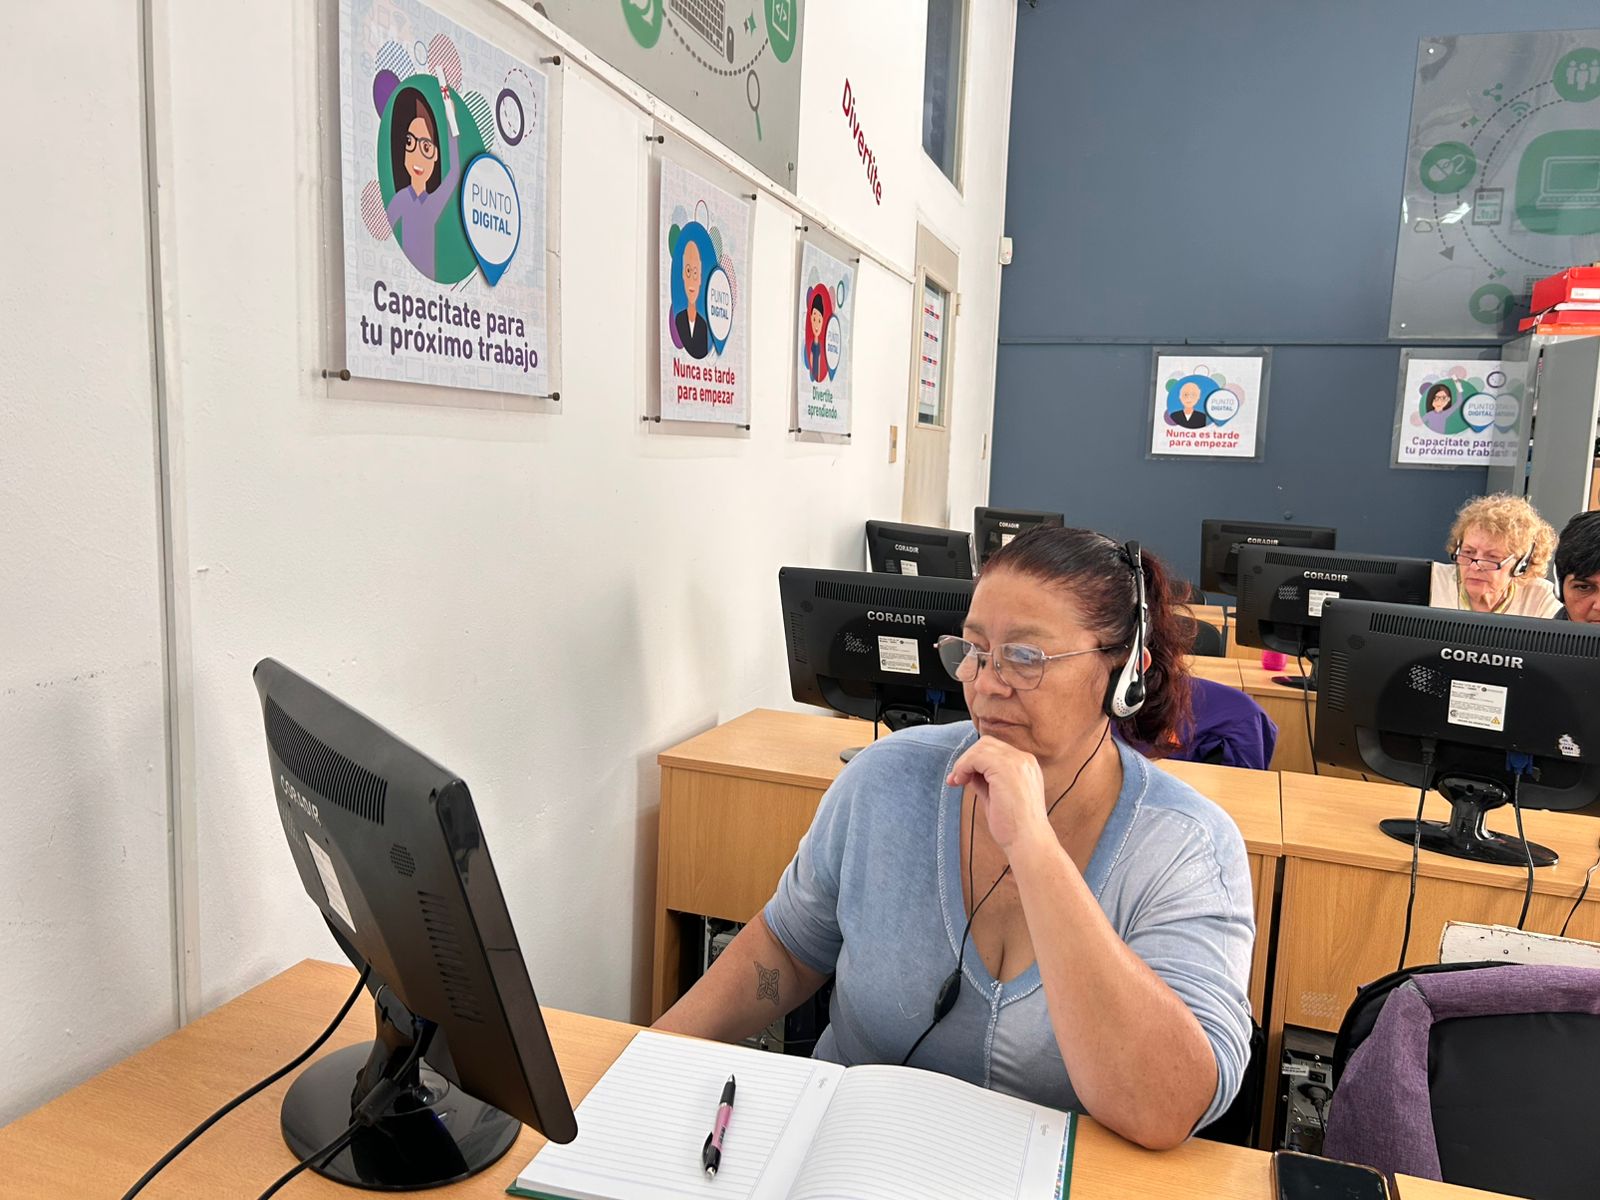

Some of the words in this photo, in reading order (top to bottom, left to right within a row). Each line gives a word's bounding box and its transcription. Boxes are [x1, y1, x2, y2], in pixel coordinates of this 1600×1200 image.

[842, 78, 882, 206] Divertite
[472, 183, 512, 215] PUNTO
[472, 209, 512, 236] DIGITAL
[711, 288, 729, 305] PUNTO
[373, 280, 481, 330] Capacitate
[486, 312, 525, 338] para
[711, 305, 729, 320] DIGITAL
[360, 315, 383, 346] tu
[390, 322, 473, 360] próximo
[478, 336, 538, 373] trabajo
[673, 357, 701, 380] Nunca
[703, 367, 713, 382] es
[714, 366, 735, 386] tarde
[677, 385, 698, 404] para
[699, 388, 734, 407] empezar
[812, 386, 833, 403] Divertite
[1211, 398, 1234, 406] PUNTO
[807, 404, 838, 419] aprendiendo
[1166, 429, 1197, 438] Nunca
[1213, 431, 1240, 439] tarde
[1194, 440, 1238, 448] empezar
[1405, 446, 1416, 454] tu
[1419, 445, 1464, 456] próximo
[1412, 436, 1470, 448] Capacitate
[1473, 441, 1493, 449] par
[894, 543, 919, 553] CORADIR
[1247, 537, 1279, 545] CORADIR
[1303, 570, 1348, 582] CORADIR
[866, 610, 926, 626] CORADIR
[1440, 647, 1523, 669] CORADIR
